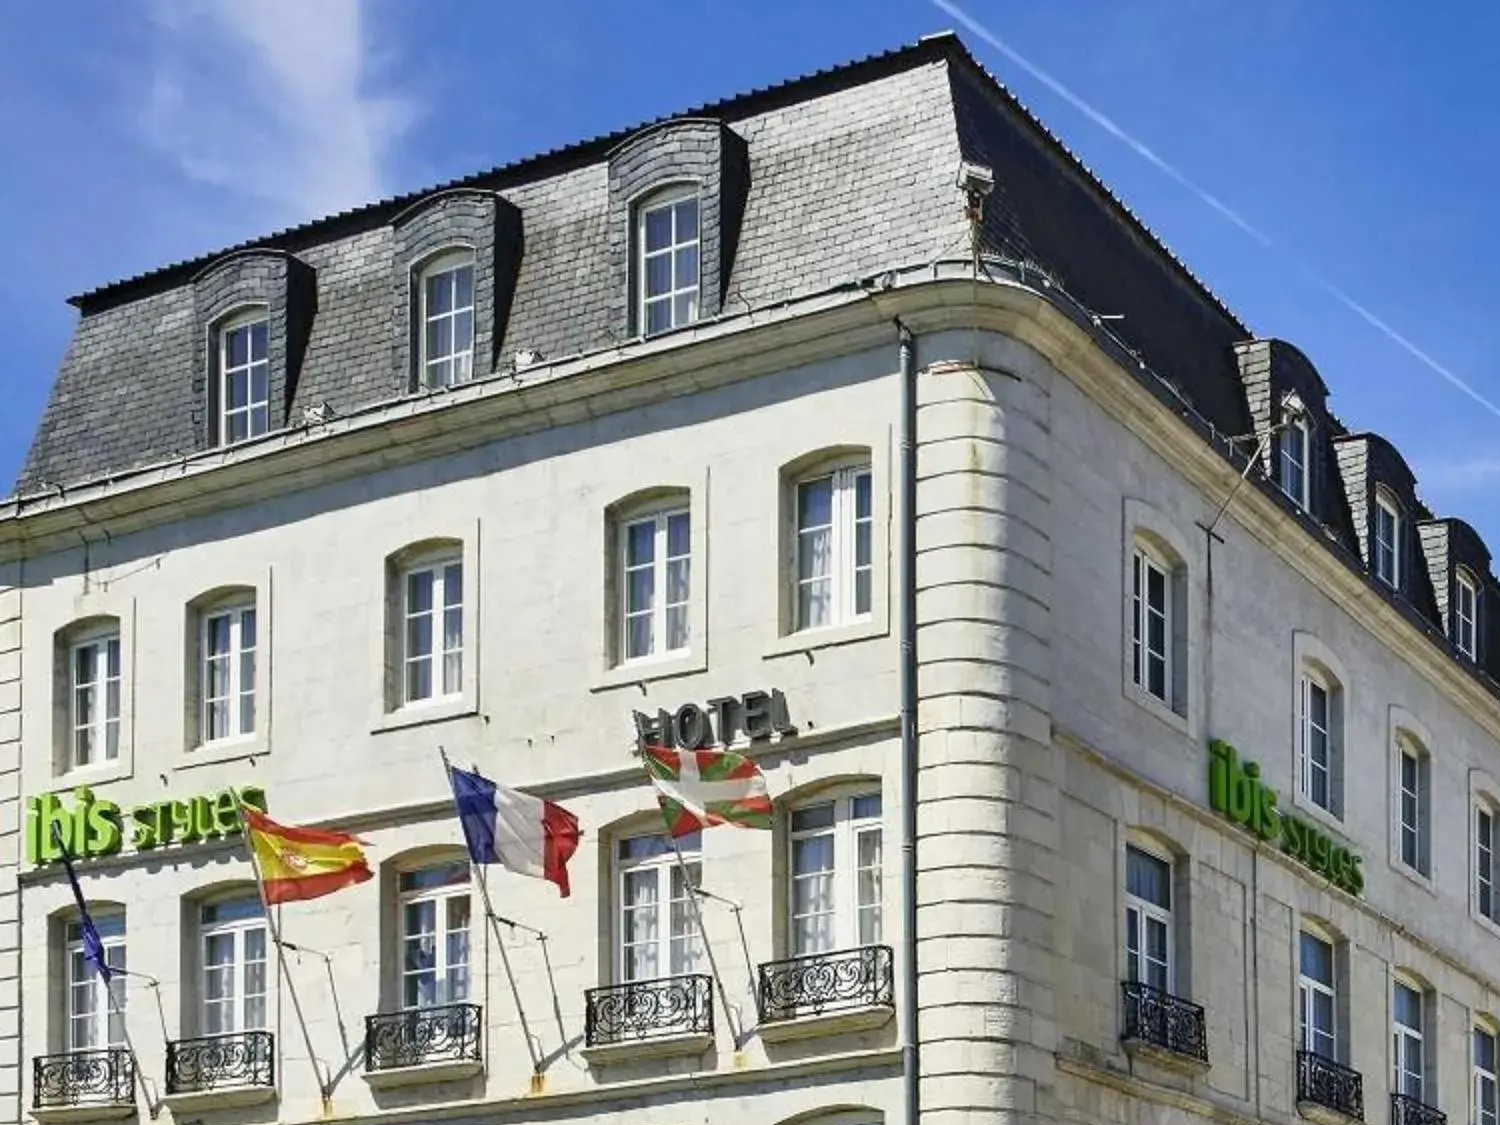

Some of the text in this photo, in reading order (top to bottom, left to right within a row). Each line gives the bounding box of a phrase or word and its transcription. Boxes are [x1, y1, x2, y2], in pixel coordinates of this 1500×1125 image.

[632, 688, 797, 751] HOTEL
[26, 785, 122, 866] ibis
[1210, 739, 1278, 840] ibis
